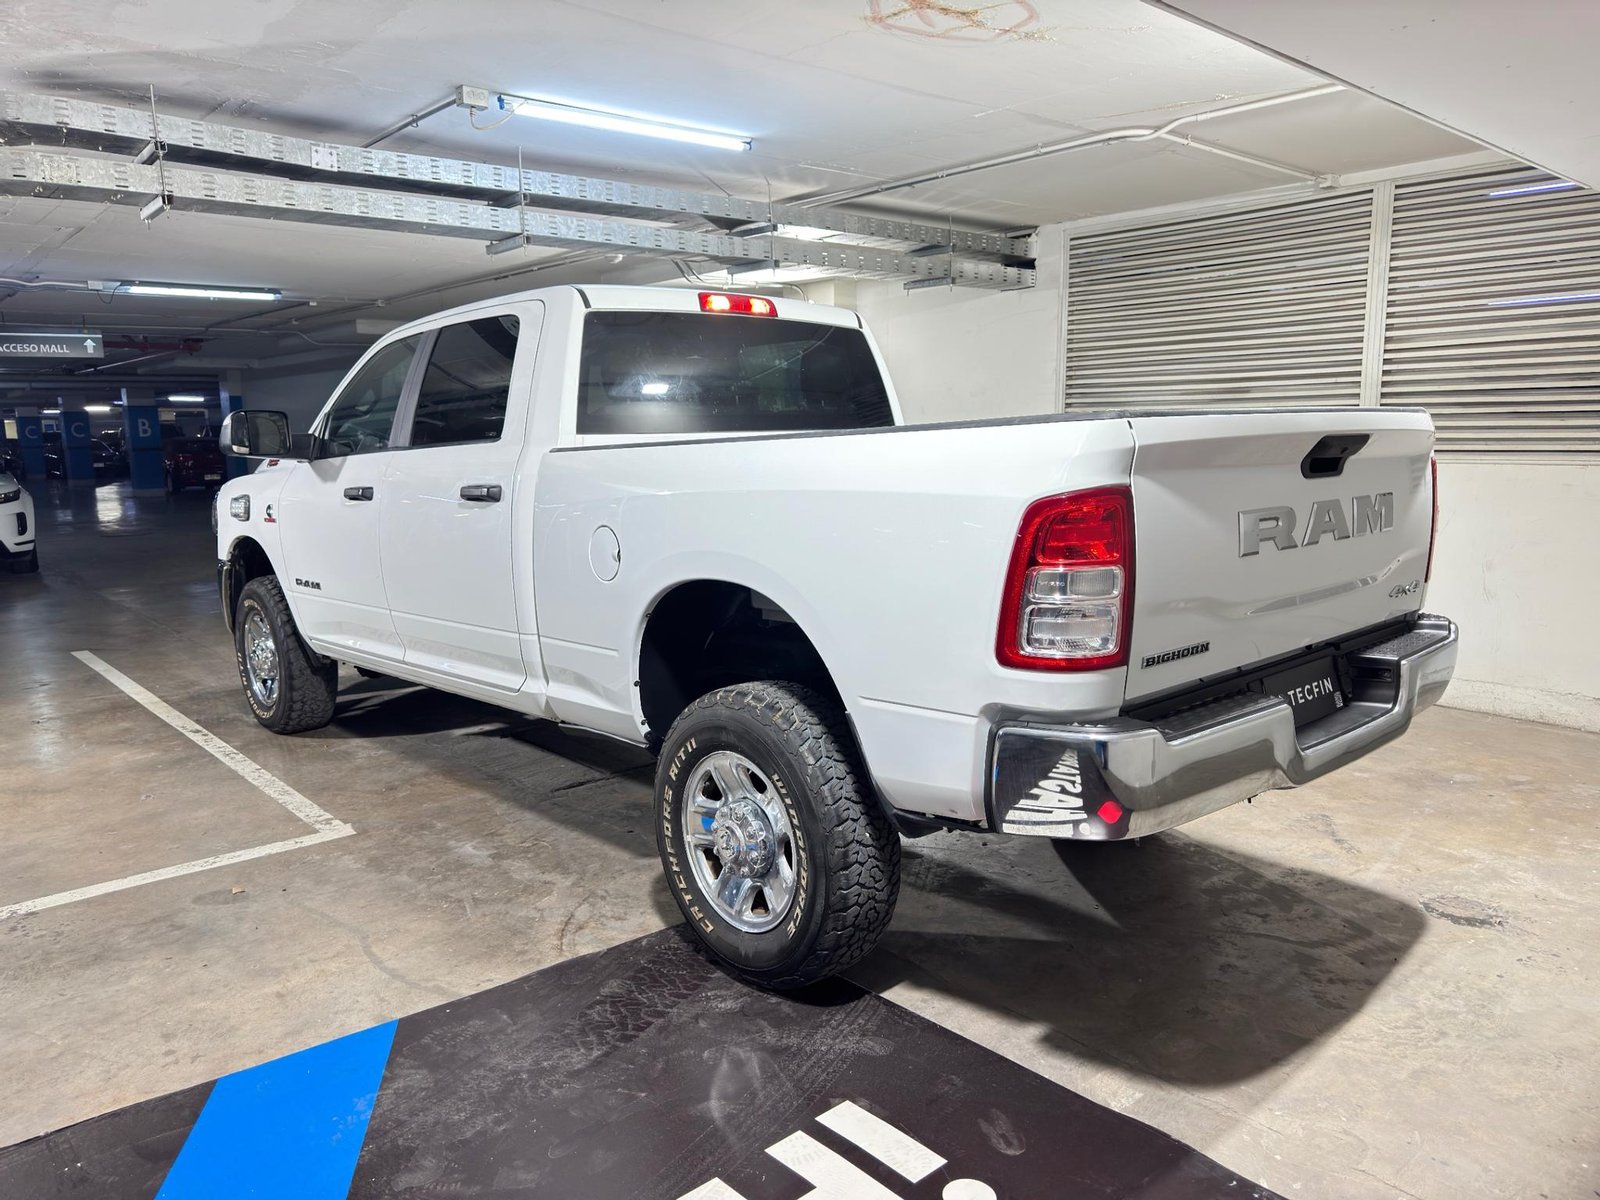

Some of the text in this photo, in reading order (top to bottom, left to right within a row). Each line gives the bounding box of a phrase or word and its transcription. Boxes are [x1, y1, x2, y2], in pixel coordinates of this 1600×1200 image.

[40, 344, 70, 353] MALL
[25, 425, 38, 439] C
[71, 422, 85, 438] C
[138, 419, 152, 437] B
[1238, 491, 1394, 558] RAM
[1141, 641, 1210, 669] BIGHORN
[1287, 677, 1333, 706] TECFIN
[663, 784, 715, 935] CATCHFORS
